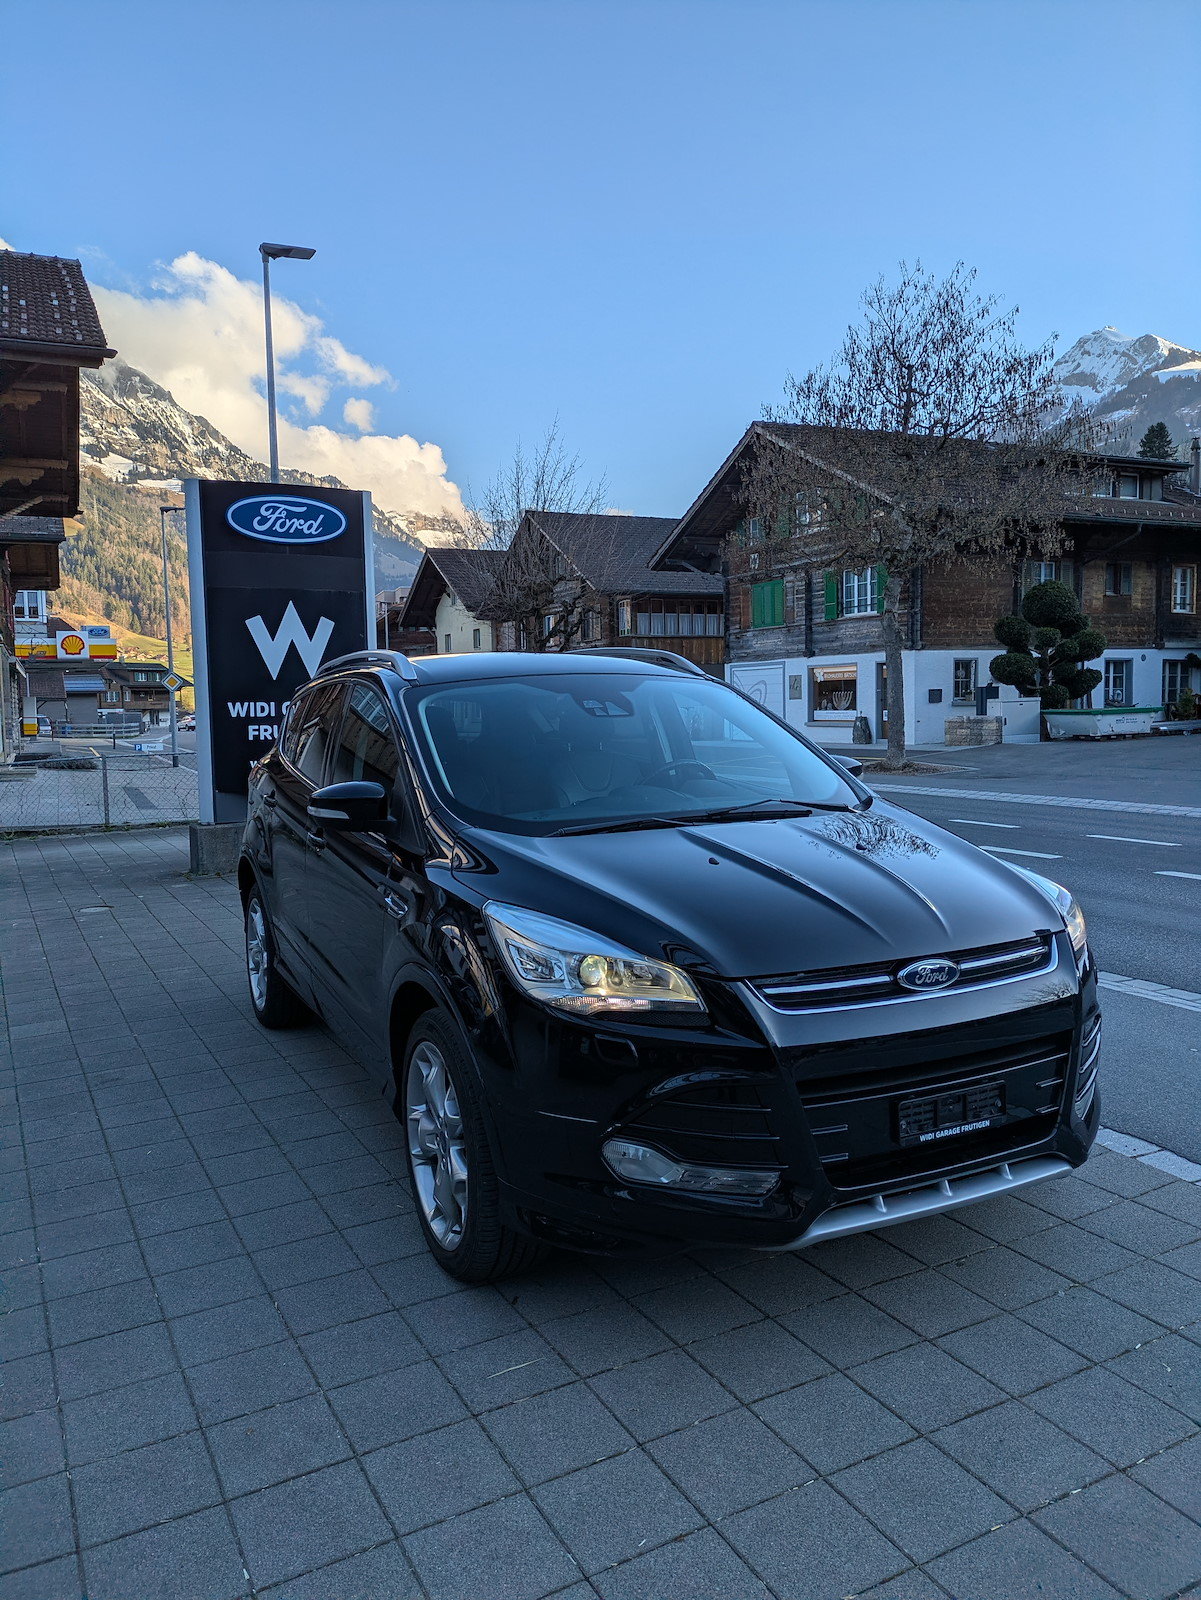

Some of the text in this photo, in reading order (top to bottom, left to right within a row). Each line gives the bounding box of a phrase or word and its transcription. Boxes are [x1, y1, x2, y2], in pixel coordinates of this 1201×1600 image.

[253, 503, 324, 535] Ford
[245, 600, 335, 681] W
[227, 701, 276, 718] WIDI
[915, 965, 949, 985] Ford
[920, 1120, 990, 1142] WIDI GARAGE FRUTIGEN
